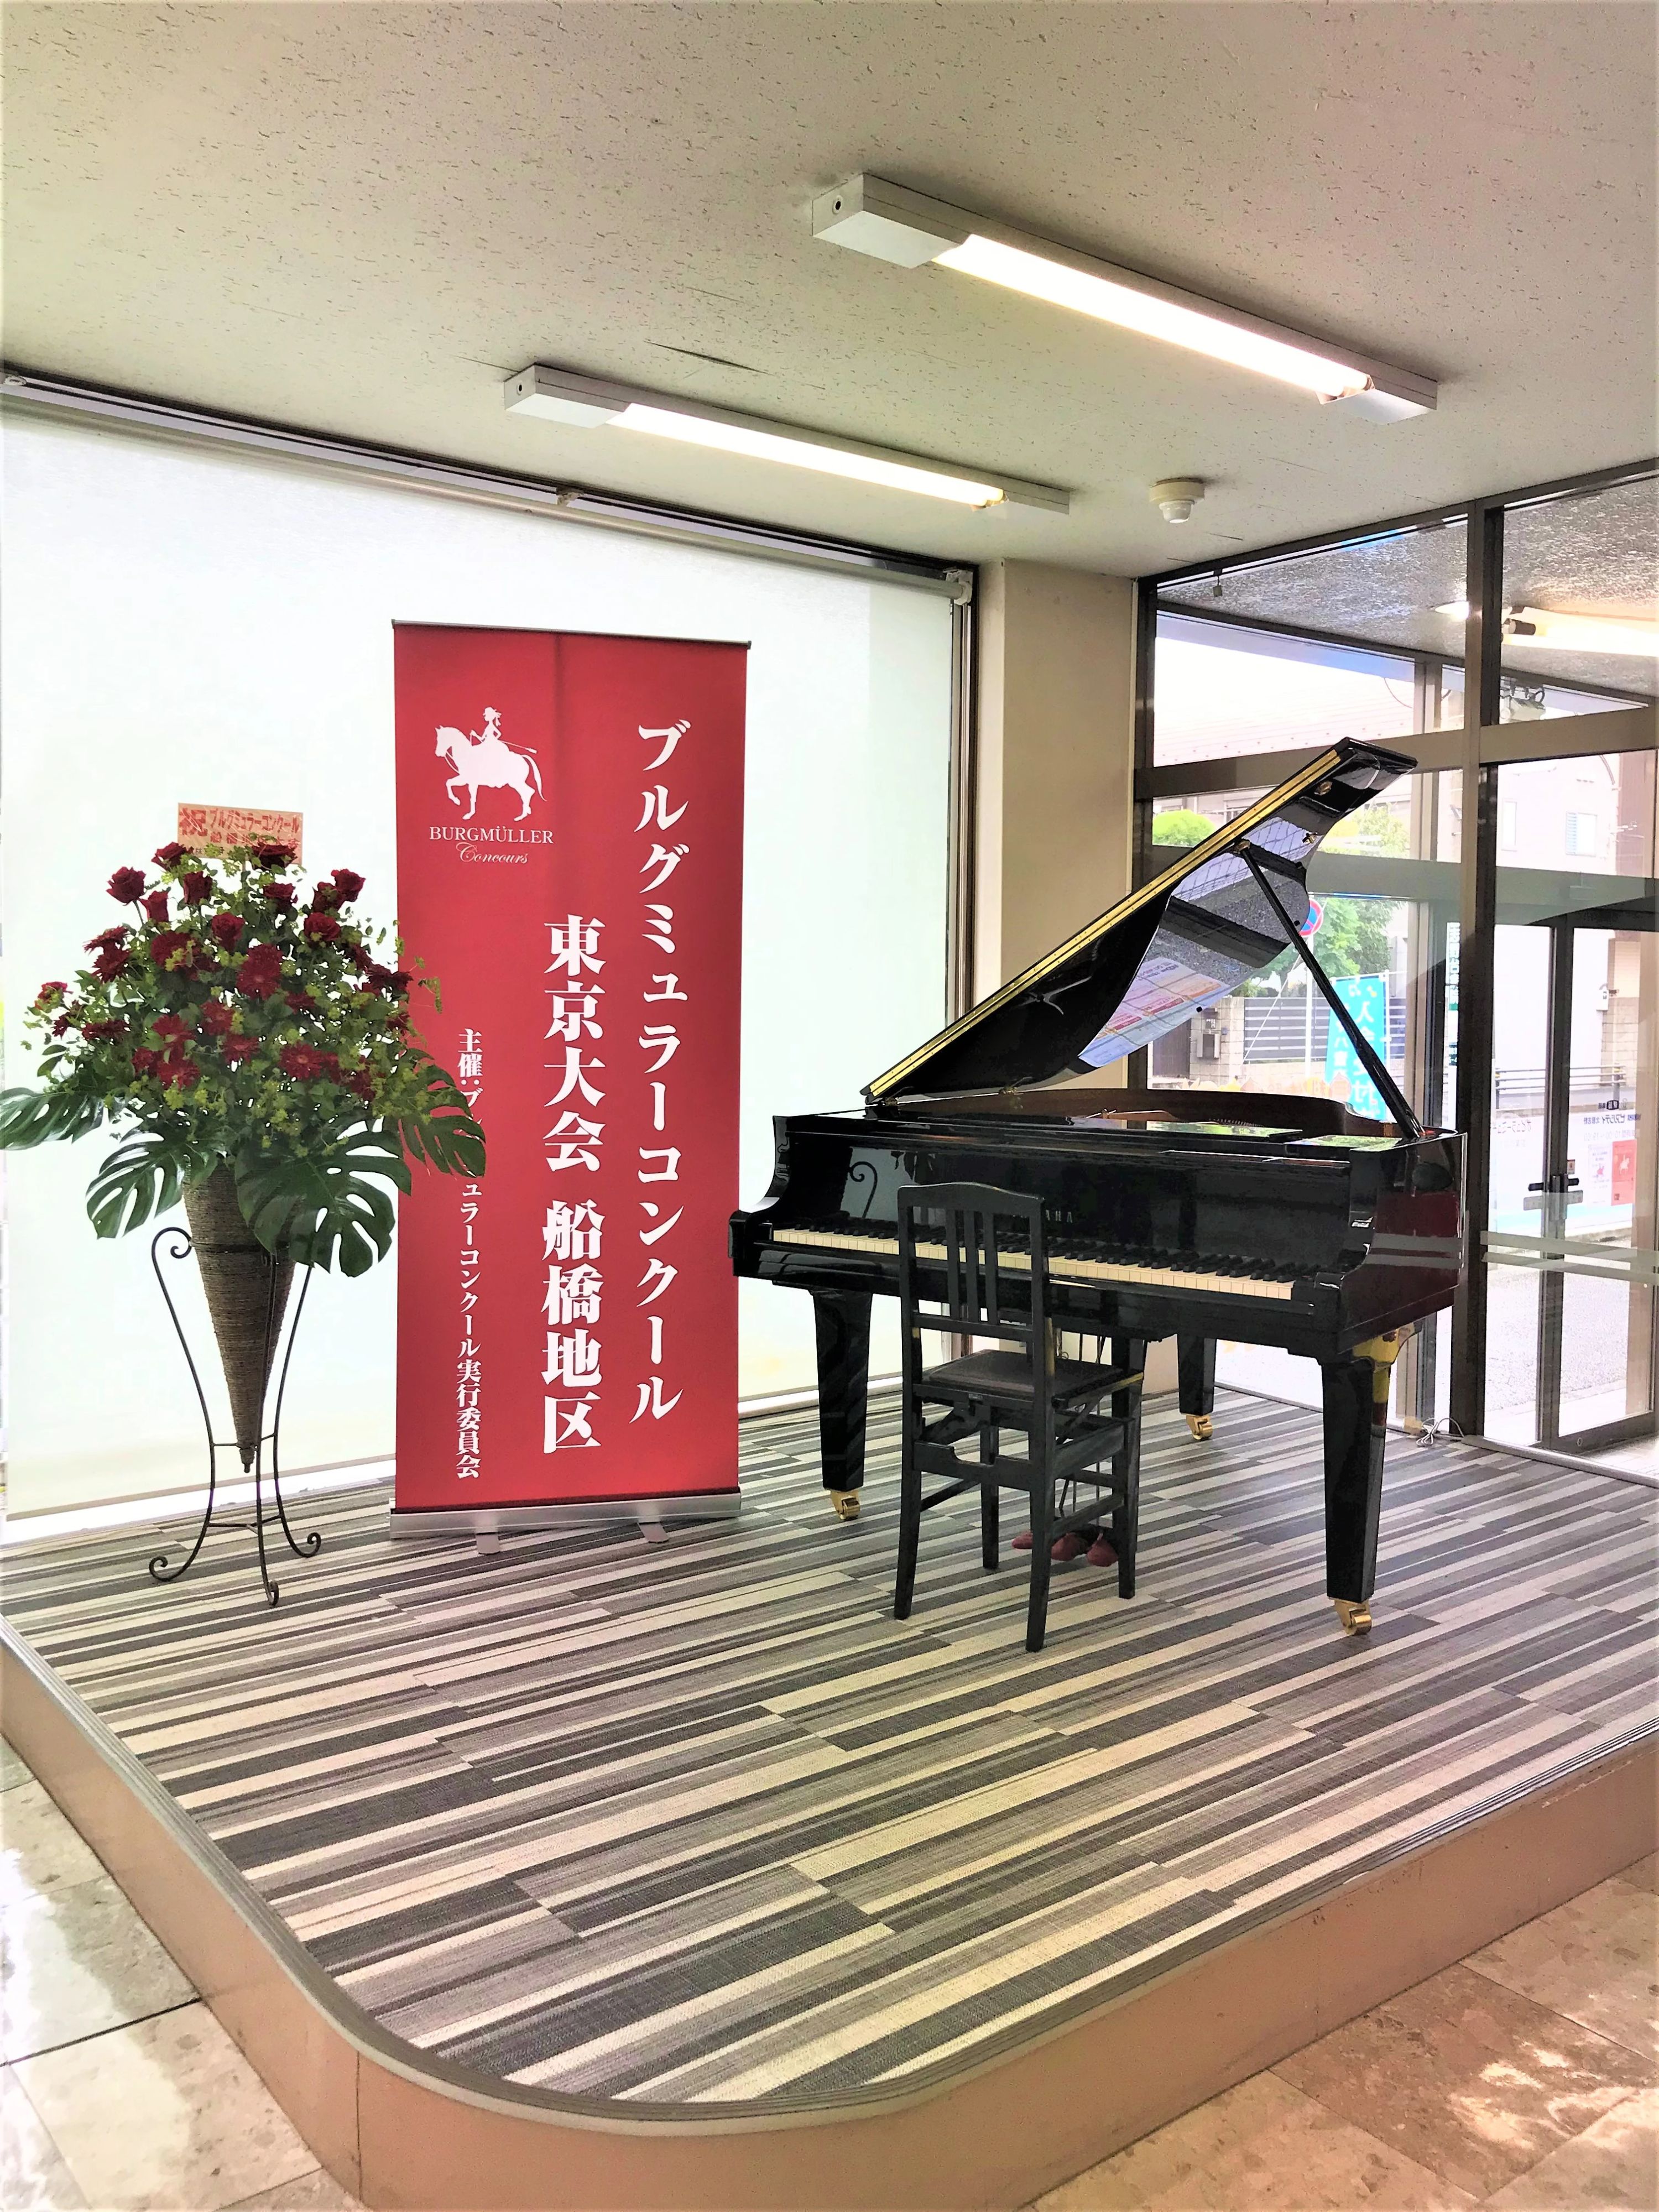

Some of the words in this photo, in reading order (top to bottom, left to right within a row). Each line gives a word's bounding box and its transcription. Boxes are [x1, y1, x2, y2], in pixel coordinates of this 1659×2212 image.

[179, 807, 208, 837] 祝
[429, 826, 554, 844] BURGMÜLLER
[455, 842, 528, 864] Concours
[542, 914, 606, 1172] 東京大会
[629, 719, 691, 1424] ブルグミュラーコンクール
[540, 1199, 606, 1454] 船橋地区
